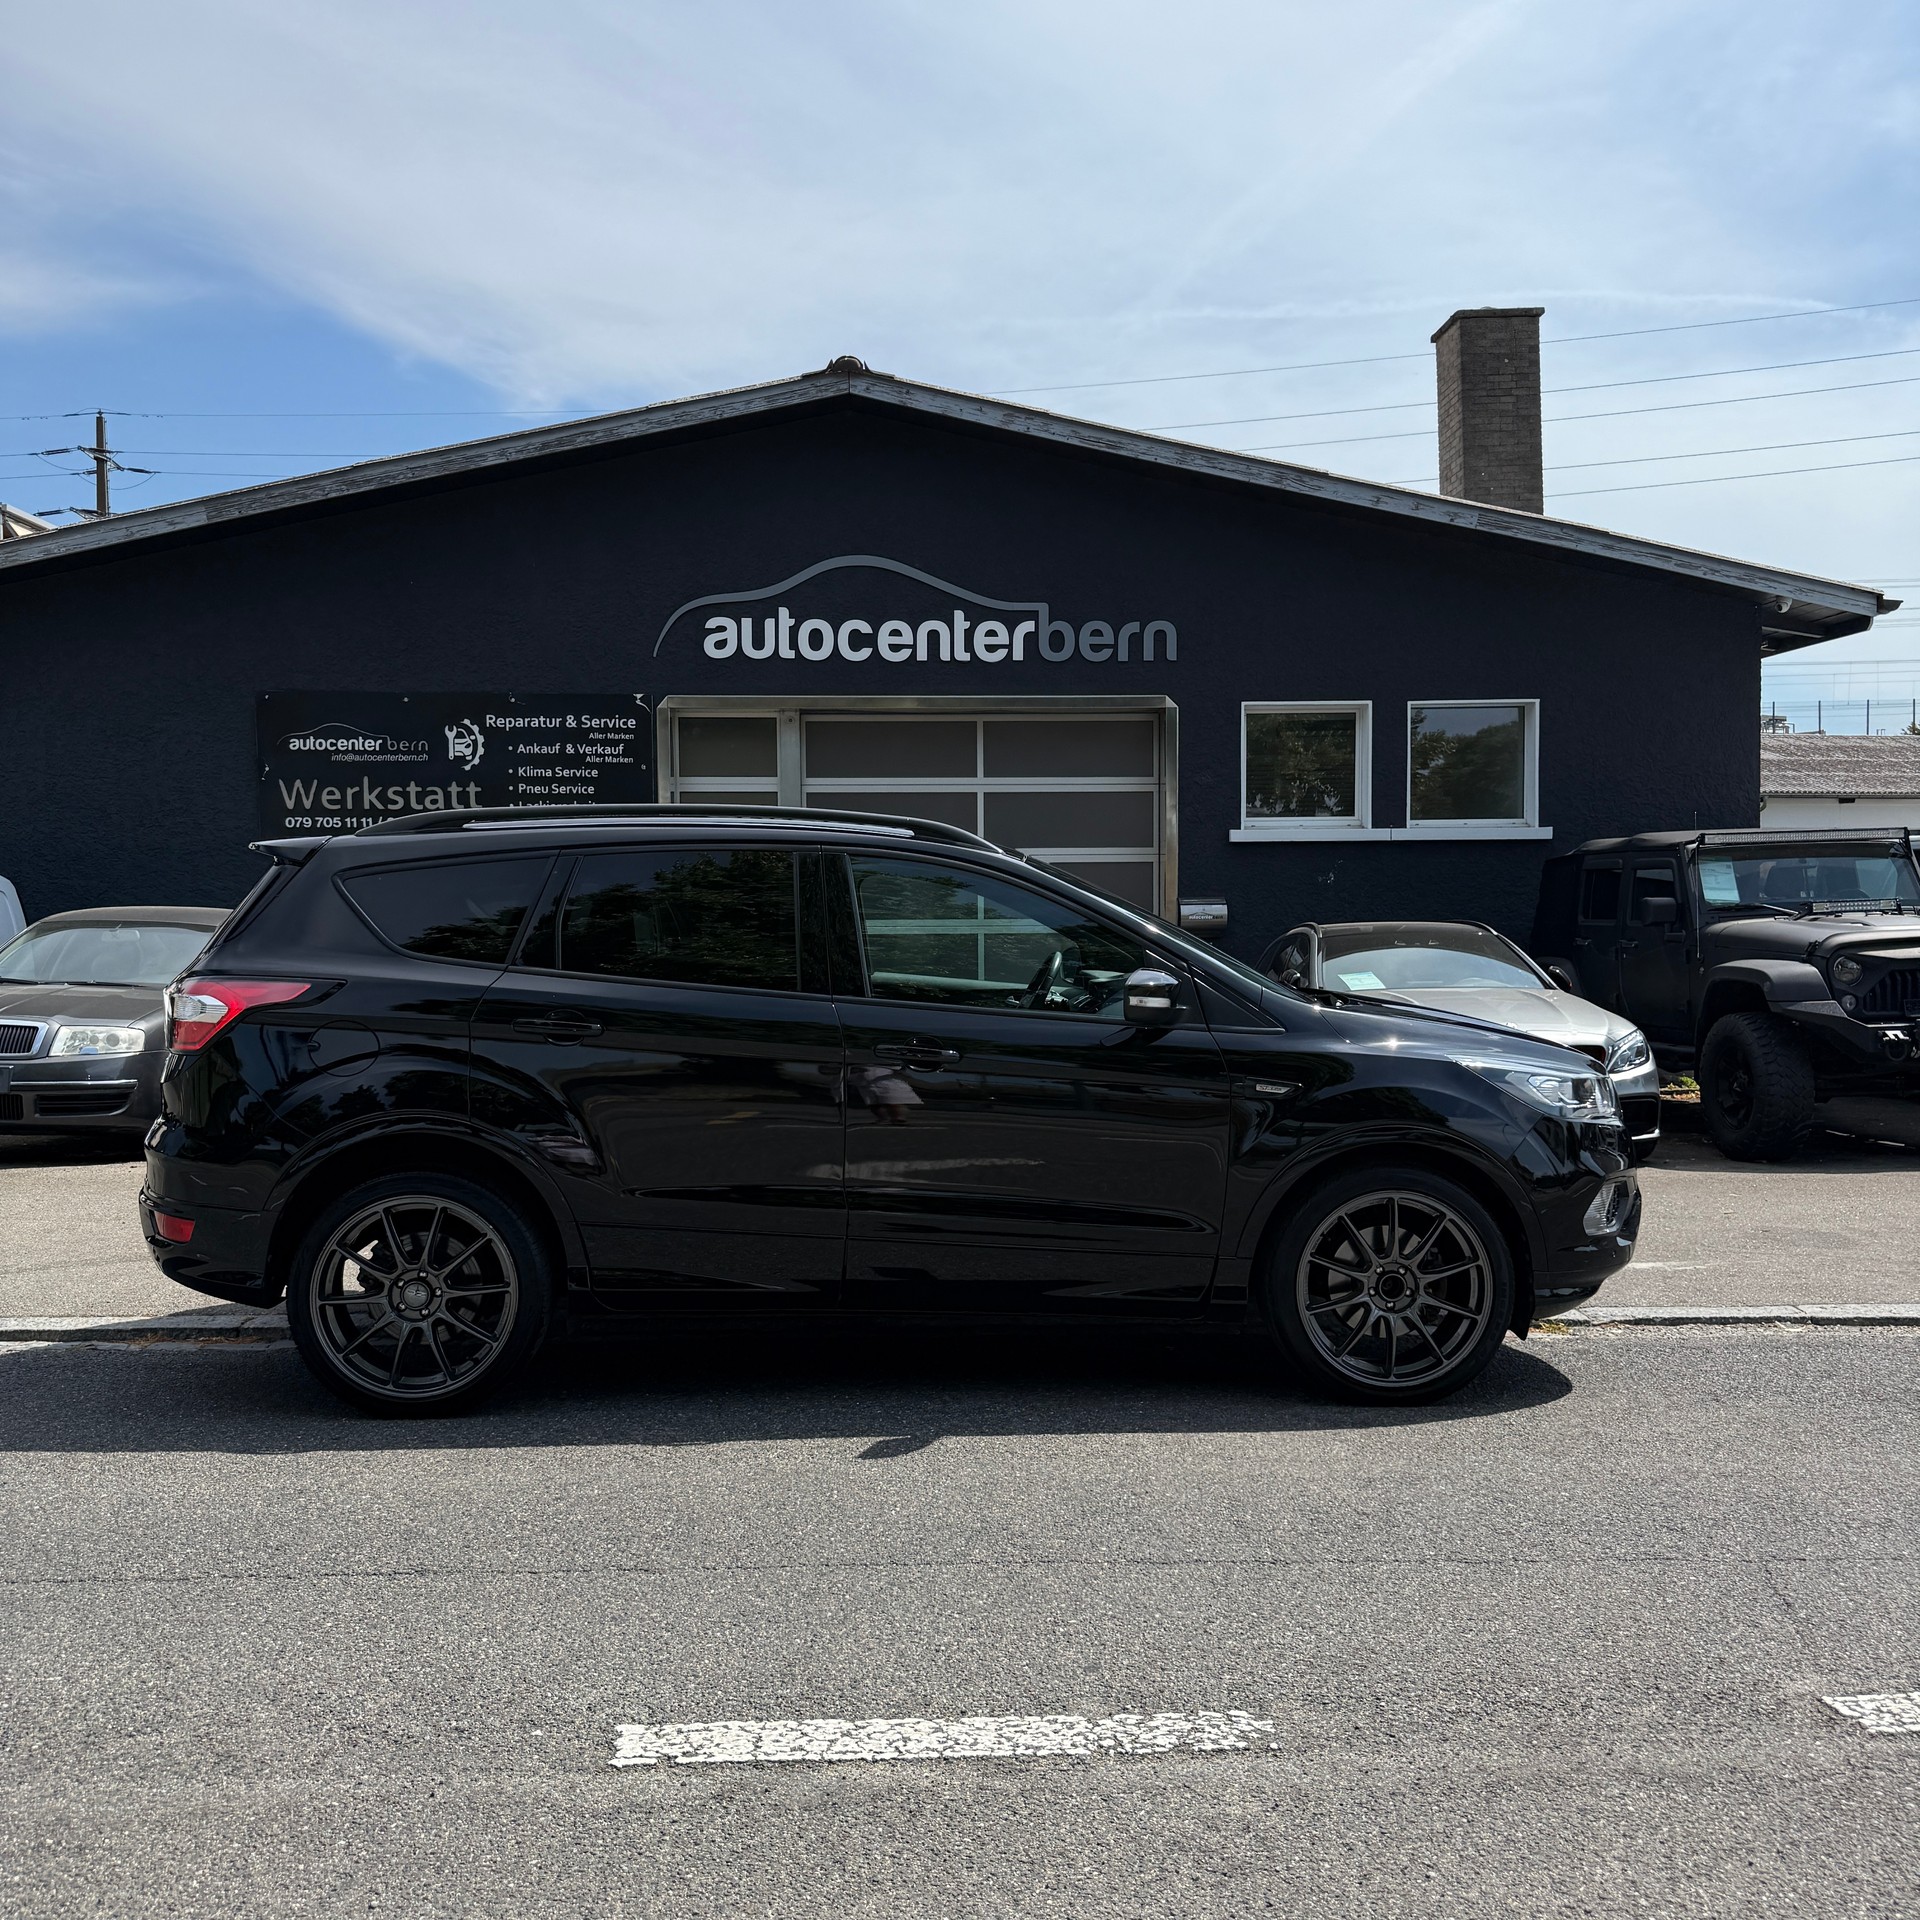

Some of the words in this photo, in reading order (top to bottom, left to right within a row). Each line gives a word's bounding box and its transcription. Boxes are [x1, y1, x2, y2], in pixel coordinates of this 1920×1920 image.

[486, 714, 563, 732] Reparatur
[565, 714, 577, 728] &
[581, 714, 637, 729] Service
[588, 732, 606, 740] Aller
[607, 732, 635, 740] Marken
[516, 743, 561, 754] Ankauf
[565, 743, 575, 755] &
[576, 743, 625, 755] Verkauf
[331, 752, 429, 762] info@autocenterbern.ch
[585, 755, 603, 763] Aller
[604, 755, 634, 763] Marken
[518, 766, 552, 777] Klima
[555, 766, 599, 778] Service
[278, 775, 483, 810] Werkstatt
[518, 783, 549, 794] Pneu
[551, 783, 595, 794] Service
[285, 816, 313, 828] 079
[314, 816, 342, 828] 705
[344, 816, 358, 828] 11
[360, 816, 373, 828] 11
